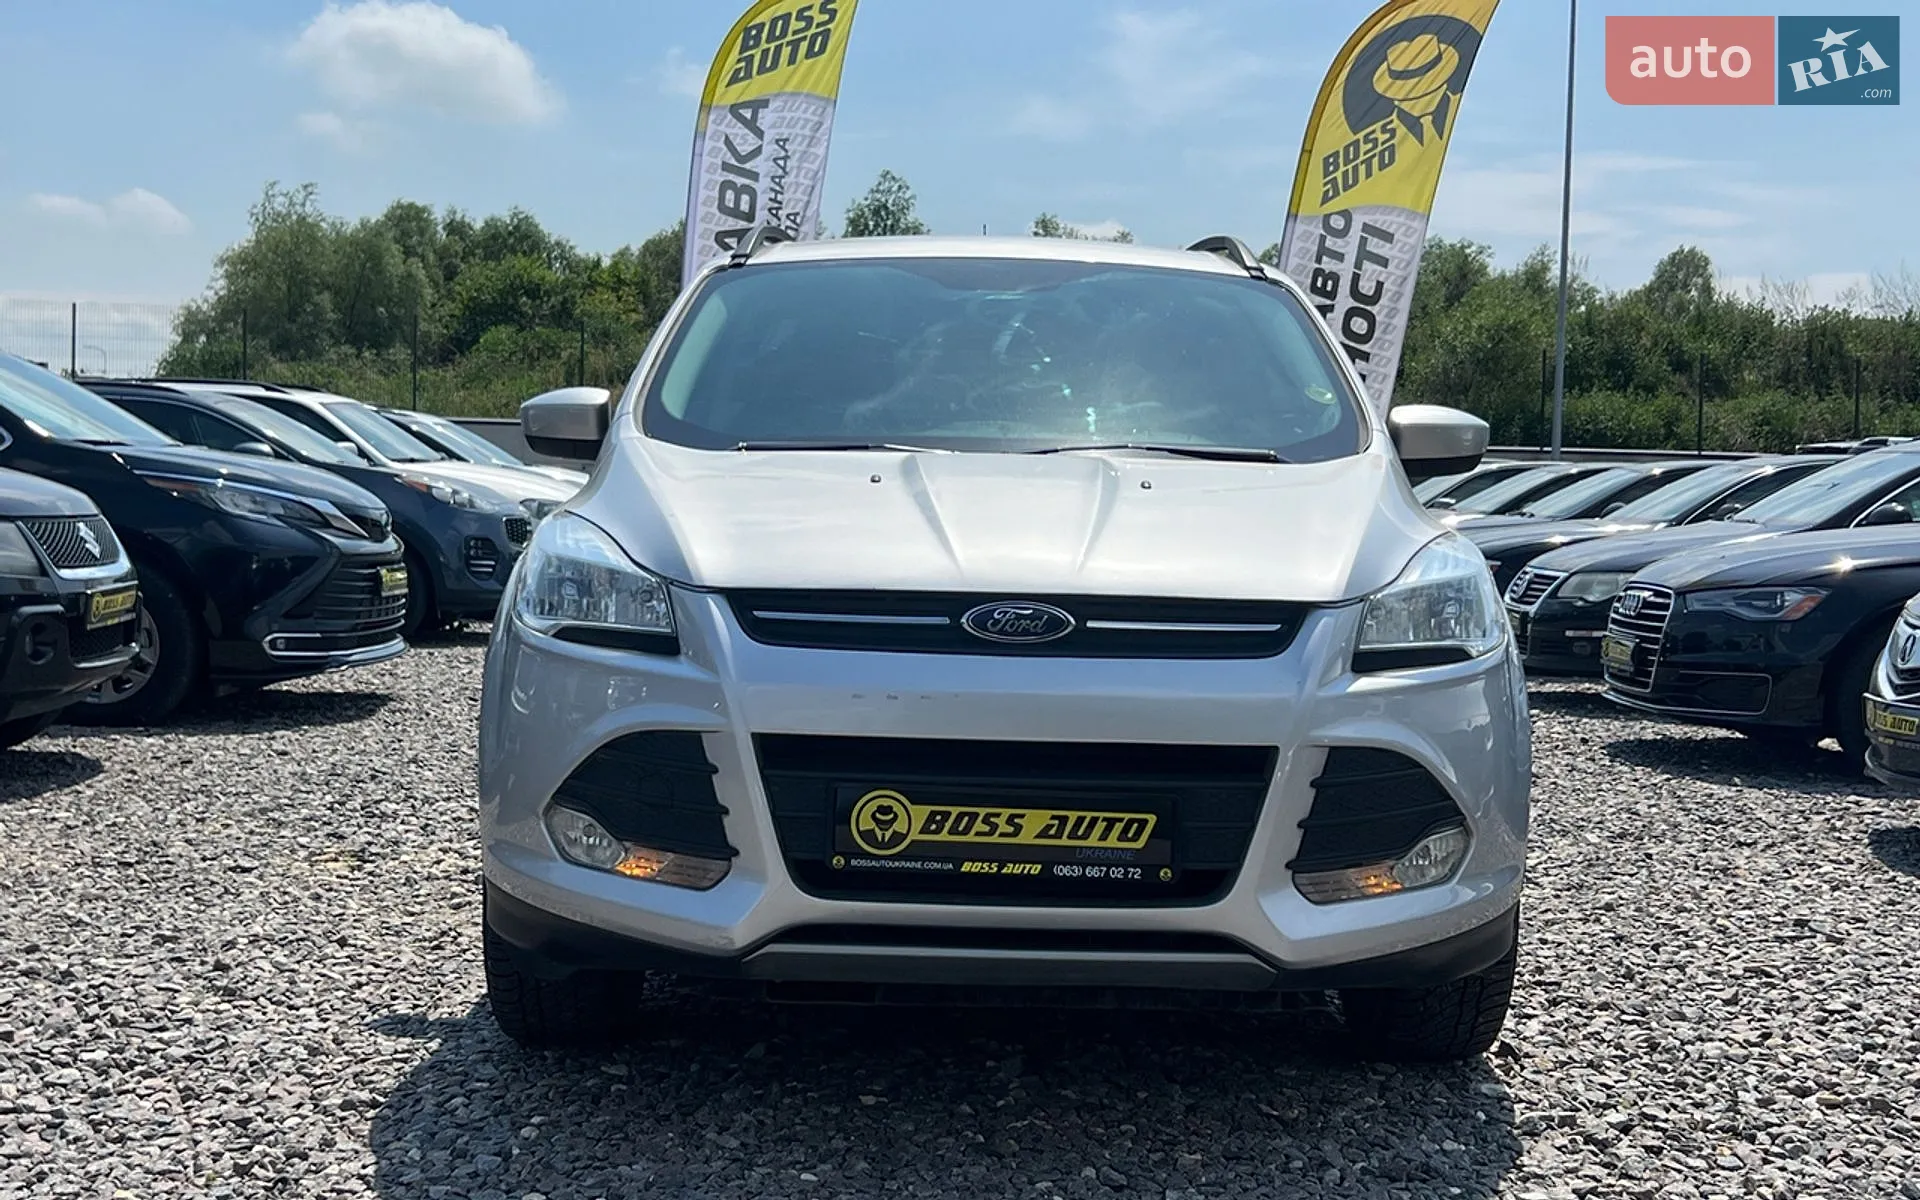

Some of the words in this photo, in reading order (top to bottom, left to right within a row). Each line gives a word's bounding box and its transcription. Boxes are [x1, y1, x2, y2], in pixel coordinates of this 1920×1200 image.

[739, 0, 838, 56] BOSS
[725, 28, 831, 88] AUTO
[1319, 142, 1396, 208] AUTO
[1322, 118, 1397, 180] BOSS
[767, 138, 791, 227] АНАДА
[986, 607, 1048, 633] Ford
[918, 810, 1026, 838] BOSS
[1033, 815, 1150, 843] AUTO
[1074, 847, 1136, 860] UKRAINE
[960, 861, 999, 874] BOSS
[1001, 863, 1043, 876] AUTO
[1053, 864, 1083, 877] (063)
[1085, 865, 1107, 878] 667
[1109, 867, 1125, 879] 02
[1127, 868, 1142, 879] 72
